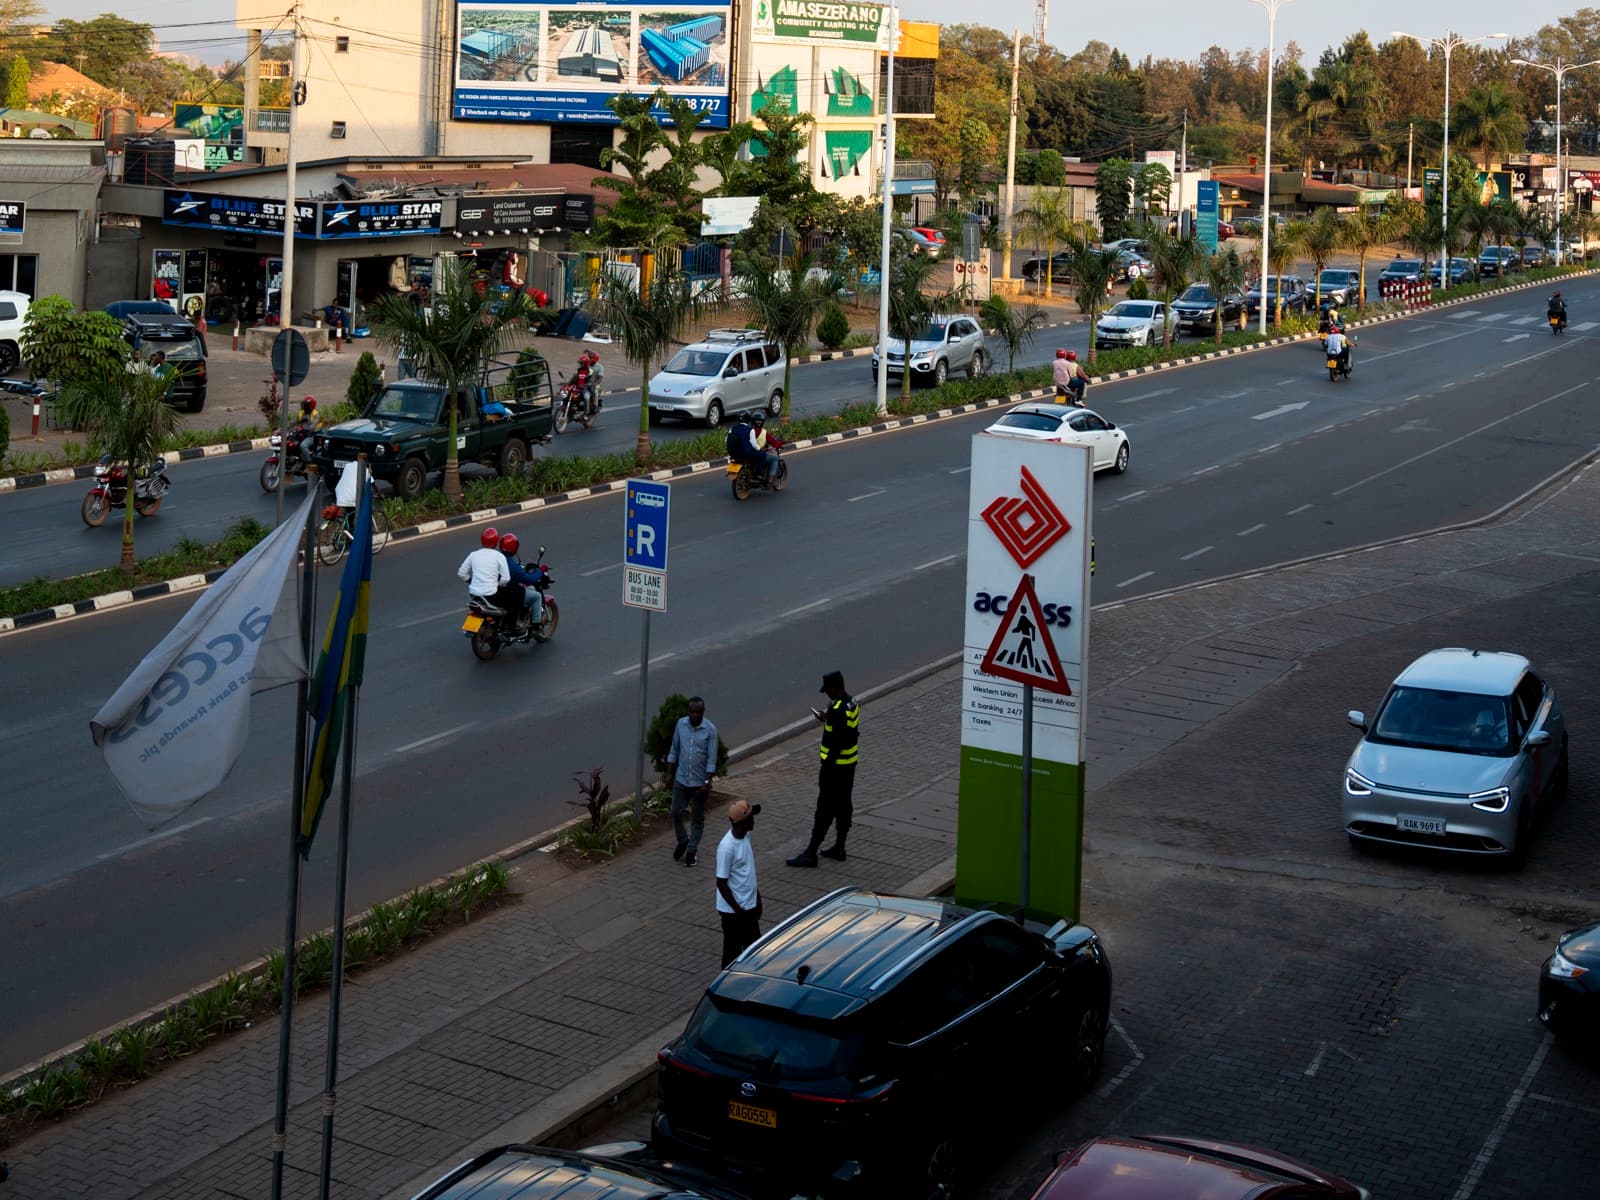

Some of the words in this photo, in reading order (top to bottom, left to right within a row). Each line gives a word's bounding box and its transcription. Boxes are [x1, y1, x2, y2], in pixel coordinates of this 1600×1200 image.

[776, 0, 879, 22] AMASEZERANO
[776, 17, 821, 27] COMMUNITY
[823, 21, 856, 30] BANKING
[700, 99, 720, 111] 727
[210, 198, 257, 211] BLUE
[360, 204, 399, 216] BLUE
[402, 203, 442, 214] STAR
[249, 213, 302, 222] ACCESSOES
[636, 524, 655, 557] R
[628, 571, 641, 584] BUS
[644, 574, 661, 588] LANE
[973, 591, 1072, 627] acss
[972, 685, 999, 696] Western
[1000, 689, 1018, 698] Union
[1032, 696, 1053, 705] ccess
[1055, 698, 1076, 708] Africa
[977, 702, 1004, 714] banking
[1007, 707, 1022, 716] 24/7
[972, 717, 991, 726] Taxes
[1403, 818, 1419, 829] RAK
[1419, 821, 1434, 831] 969
[1435, 822, 1441, 832] E
